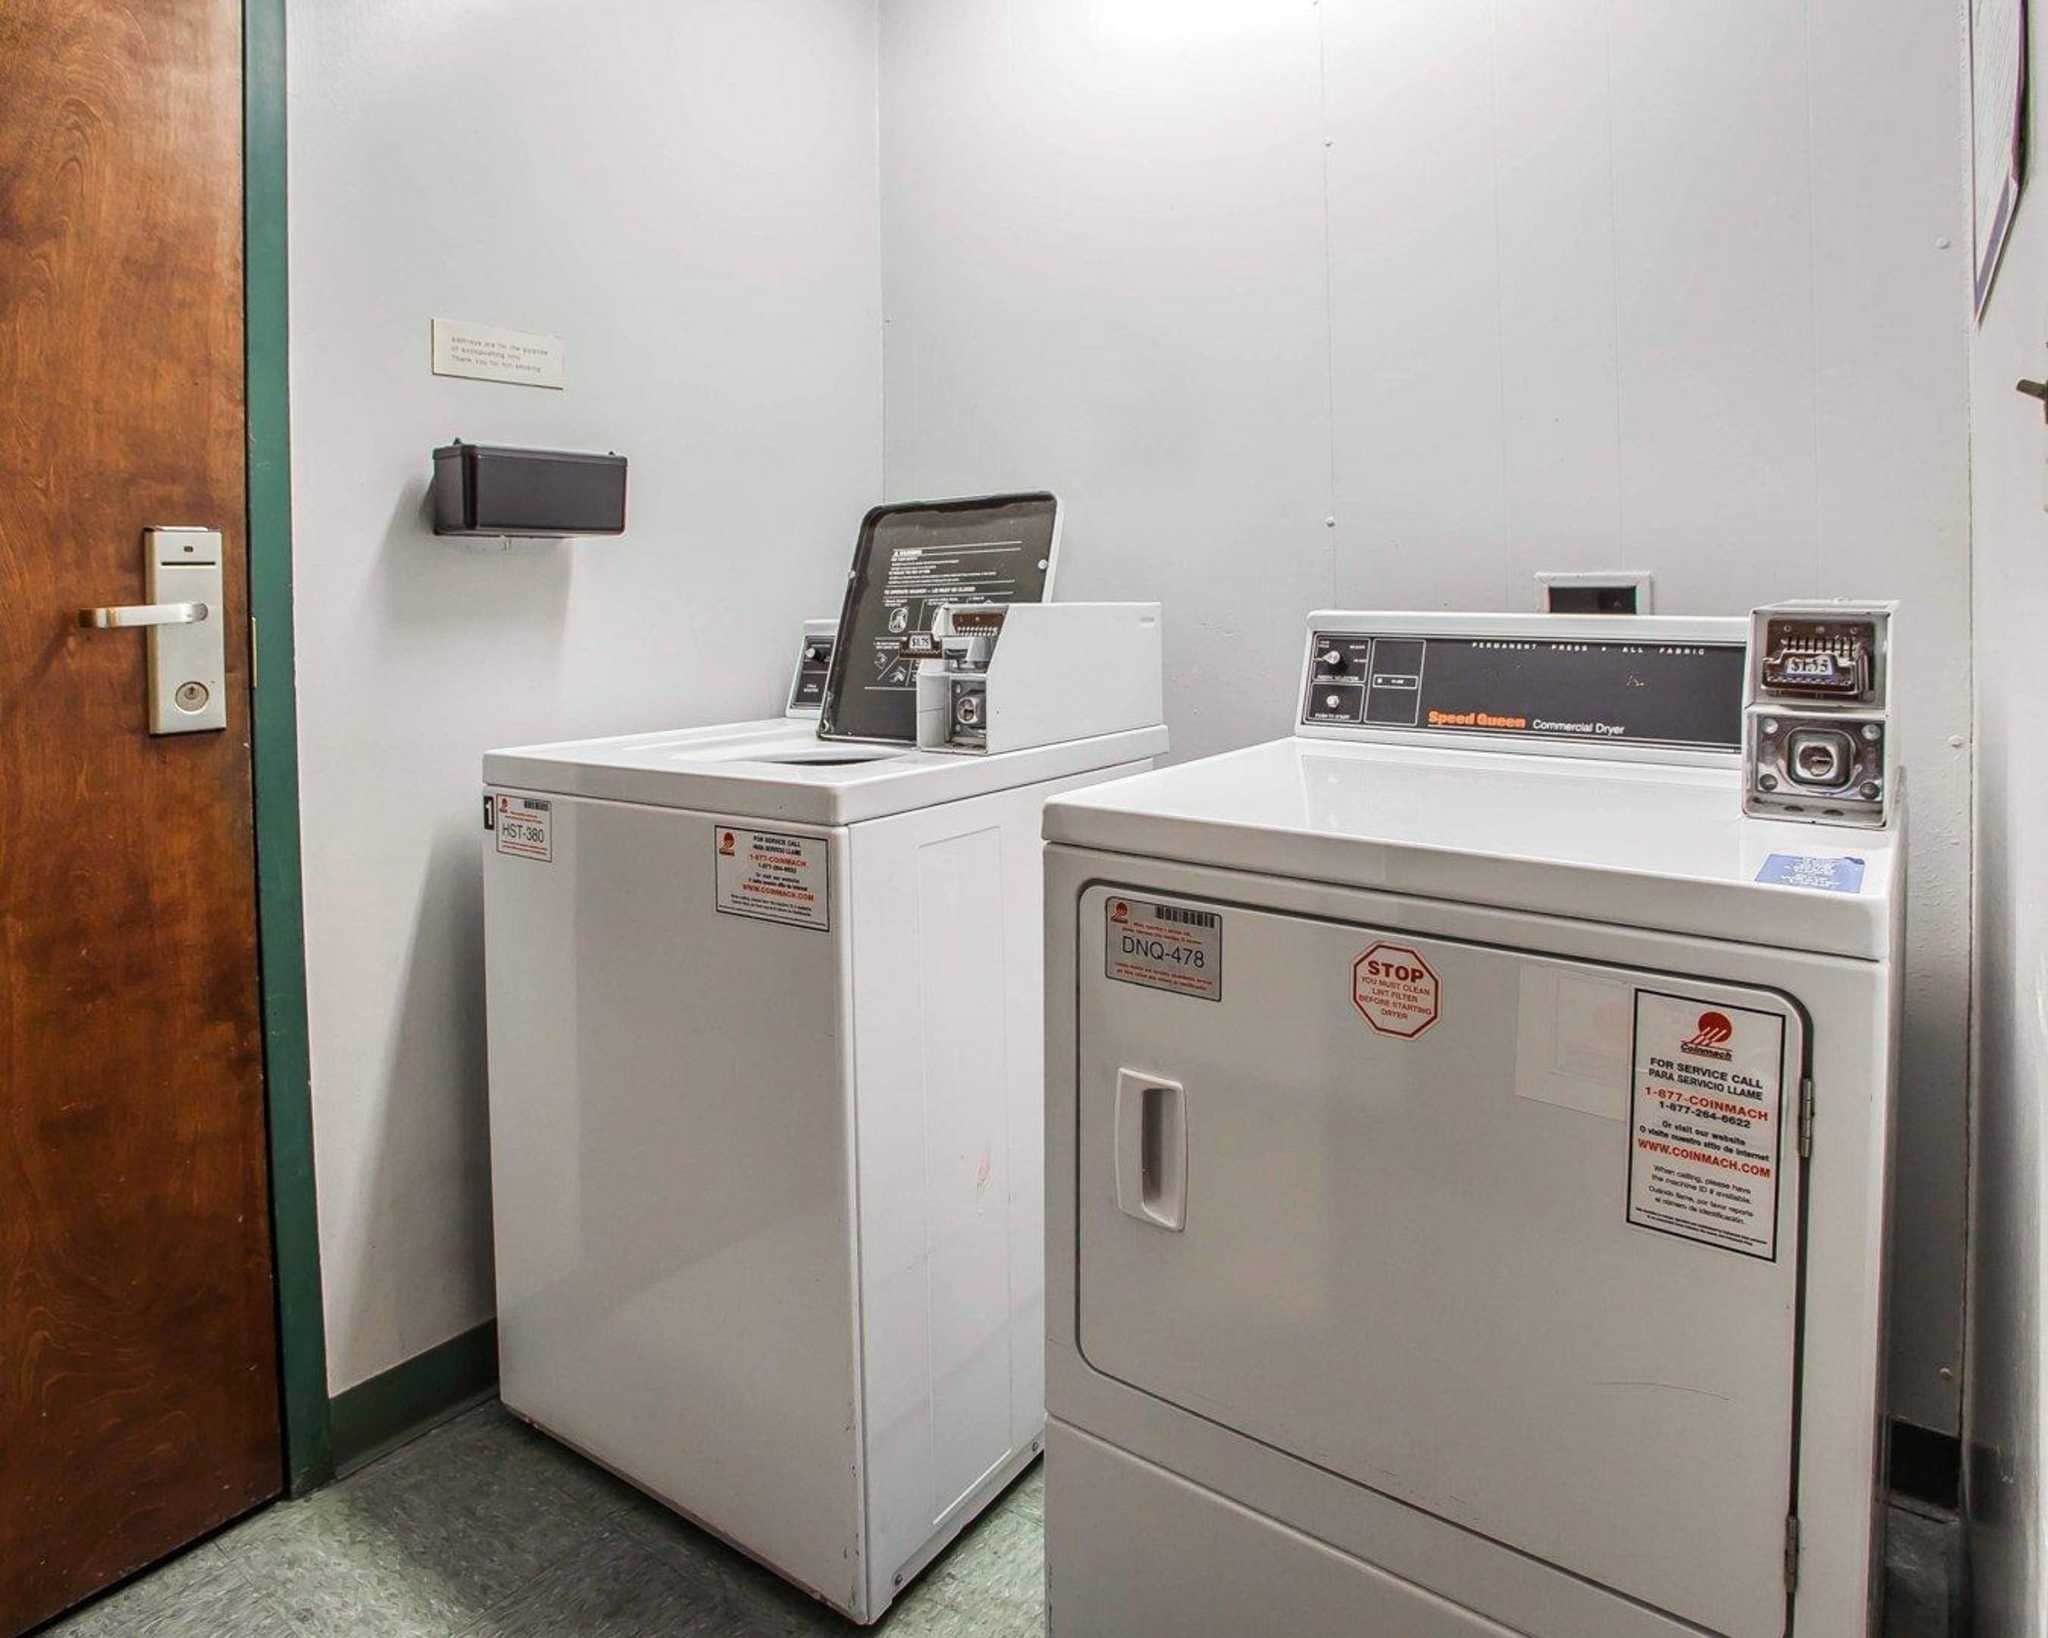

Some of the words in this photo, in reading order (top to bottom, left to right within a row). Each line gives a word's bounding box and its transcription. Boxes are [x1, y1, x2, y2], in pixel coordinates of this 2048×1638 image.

[1622, 646, 1643, 654] ALL
[1428, 711, 1475, 727] Speed
[1476, 712, 1526, 729] Queen
[1532, 719, 1593, 733] Commercial
[1595, 722, 1625, 736] Dryer
[486, 800, 492, 825] 1
[502, 823, 544, 843] HST-380
[1121, 935, 1205, 969] DNQ-478
[1368, 960, 1424, 982] STOP
[1361, 976, 1377, 985] YOU
[1379, 979, 1400, 990] MUST
[1403, 984, 1430, 996] CLEAN
[1372, 988, 1389, 997] LINT
[1391, 992, 1418, 1003] FILTER
[1359, 994, 1390, 1006] BEFORE
[1392, 1002, 1432, 1015] STARTING
[1381, 1008, 1408, 1019] DRYER
[1681, 1043, 1732, 1060] Coinmach
[1649, 1069, 1674, 1081] PARA
[1677, 1075, 1724, 1092] SERVICIO
[1727, 1085, 1763, 1100] LLAME
[1650, 1058, 1674, 1069] FOR
[1677, 1063, 1728, 1081] SERVICE
[1731, 1074, 1763, 1089] CALL
[1645, 1086, 1768, 1121] 1-877-COINMACH
[1659, 1101, 1751, 1129] 1-877-264-6622
[1662, 1120, 1672, 1129] Or
[1675, 1124, 1692, 1133] visit
[1711, 1132, 1745, 1146] website
[1638, 1139, 1771, 1178] WWW.COINMACH.COM
[1723, 1145, 1733, 1154] de
